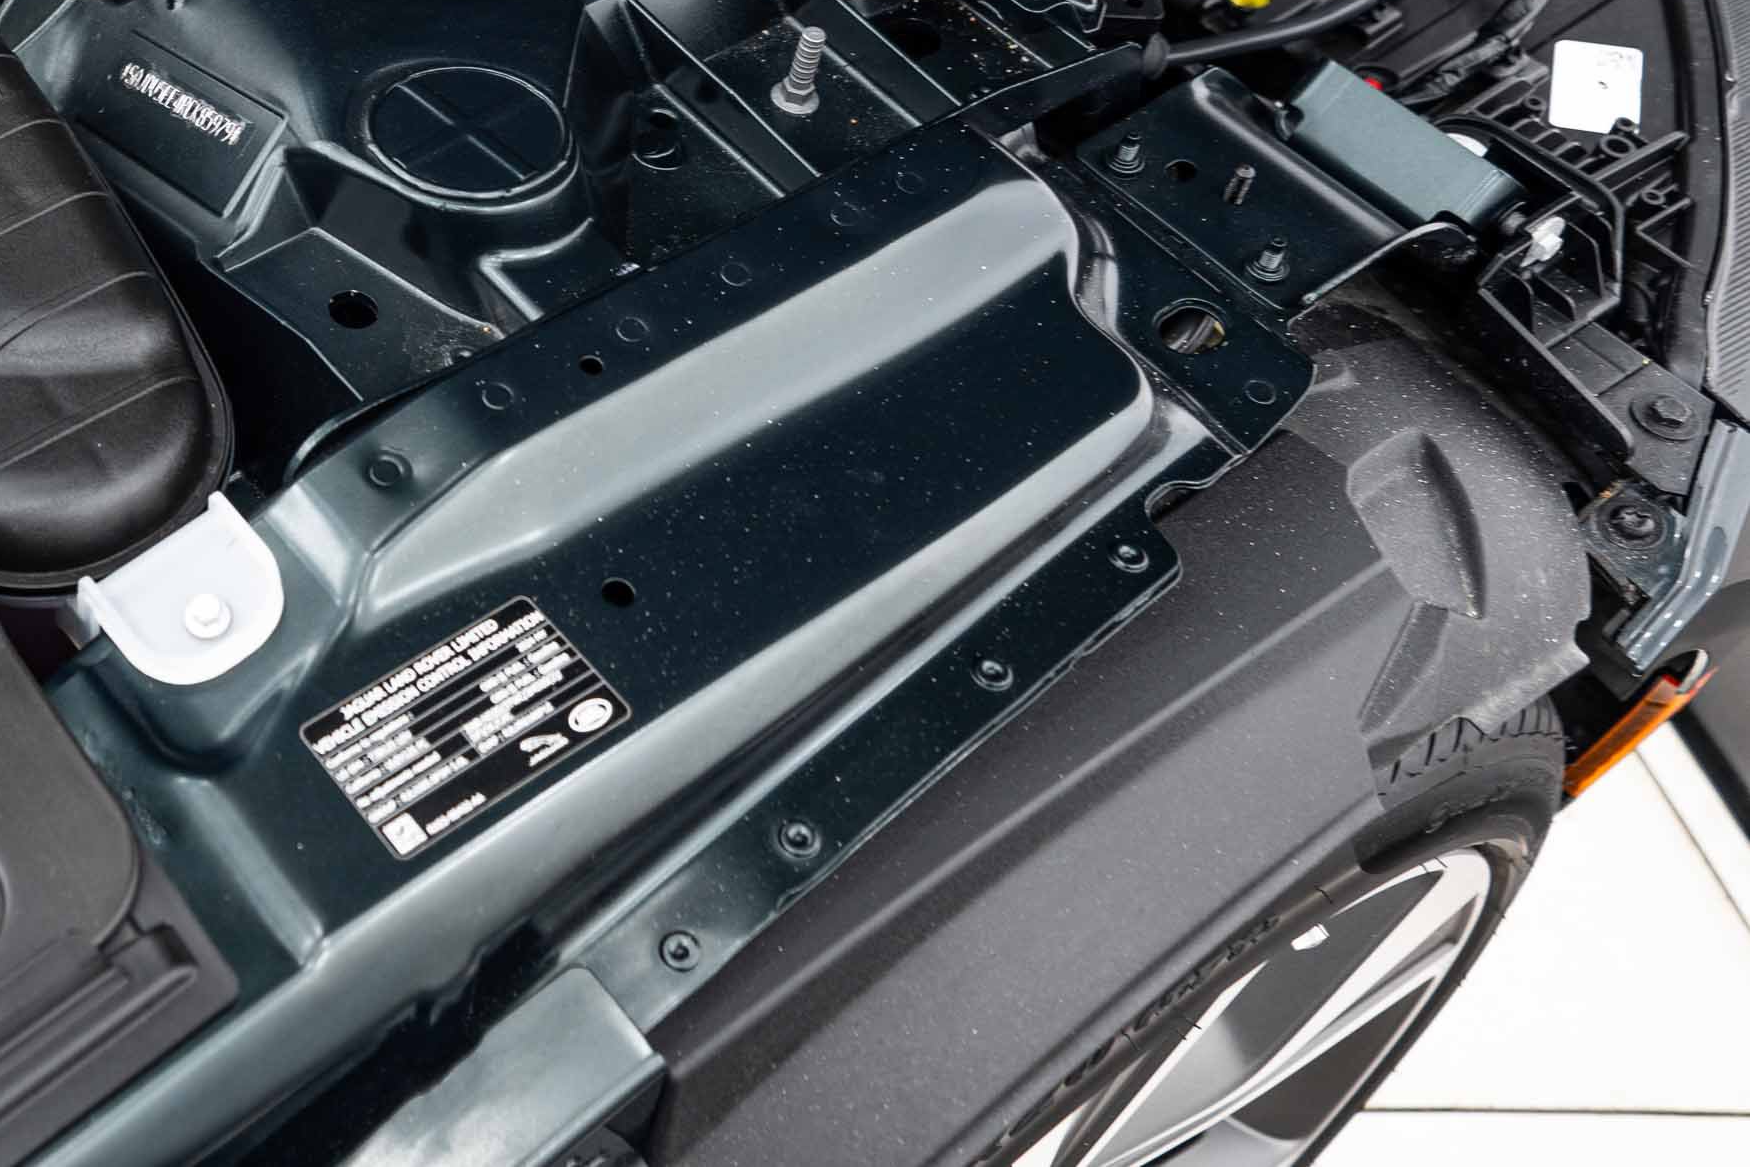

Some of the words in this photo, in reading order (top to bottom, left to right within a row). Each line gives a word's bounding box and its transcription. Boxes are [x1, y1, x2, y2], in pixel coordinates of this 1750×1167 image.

[338, 684, 388, 720] JAGUAR
[382, 666, 418, 694] LAND
[412, 644, 456, 676] ROVER
[449, 617, 500, 653] LIMITED
[414, 652, 472, 694] CONTROL
[466, 608, 545, 662] INFORMATION
